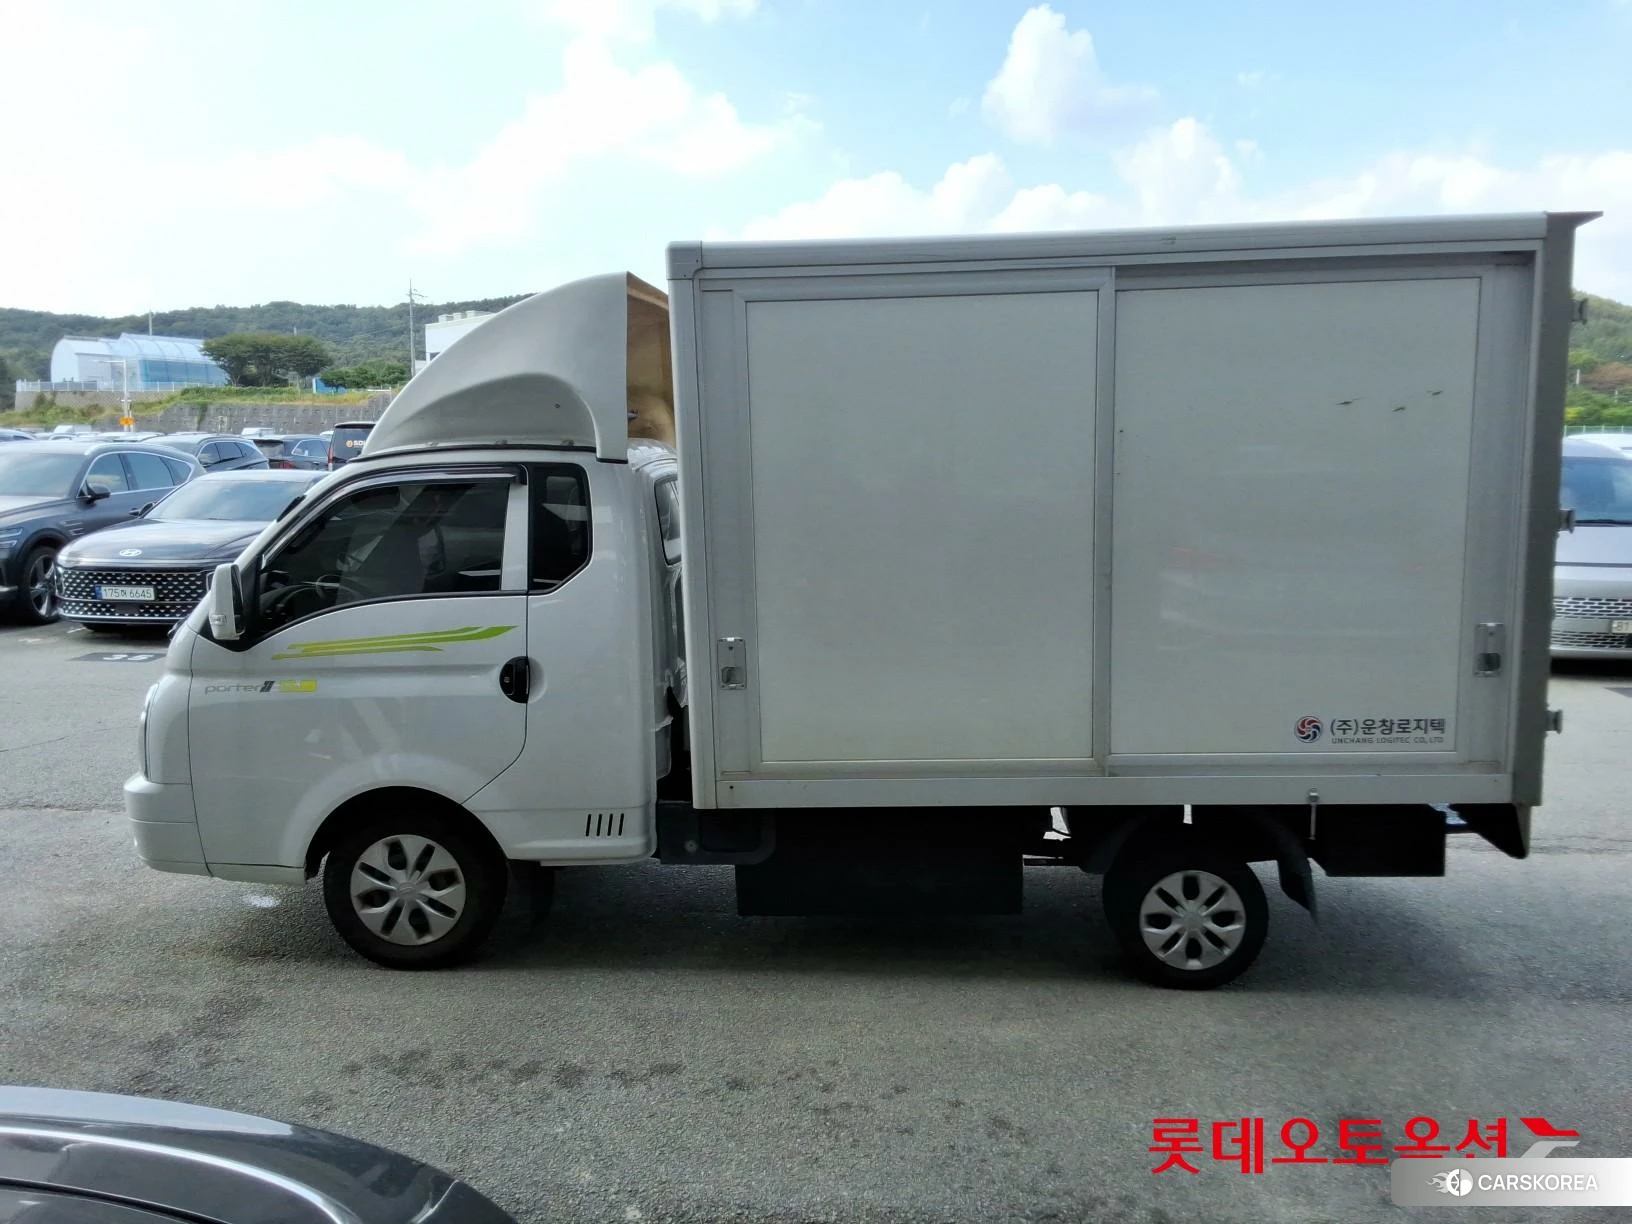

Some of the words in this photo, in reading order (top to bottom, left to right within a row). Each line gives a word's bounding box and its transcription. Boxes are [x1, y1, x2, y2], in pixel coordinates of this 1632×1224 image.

[129, 589, 152, 599] 6645
[204, 684, 260, 695] porter
[1330, 718, 1446, 736] (주)운창로지텍
